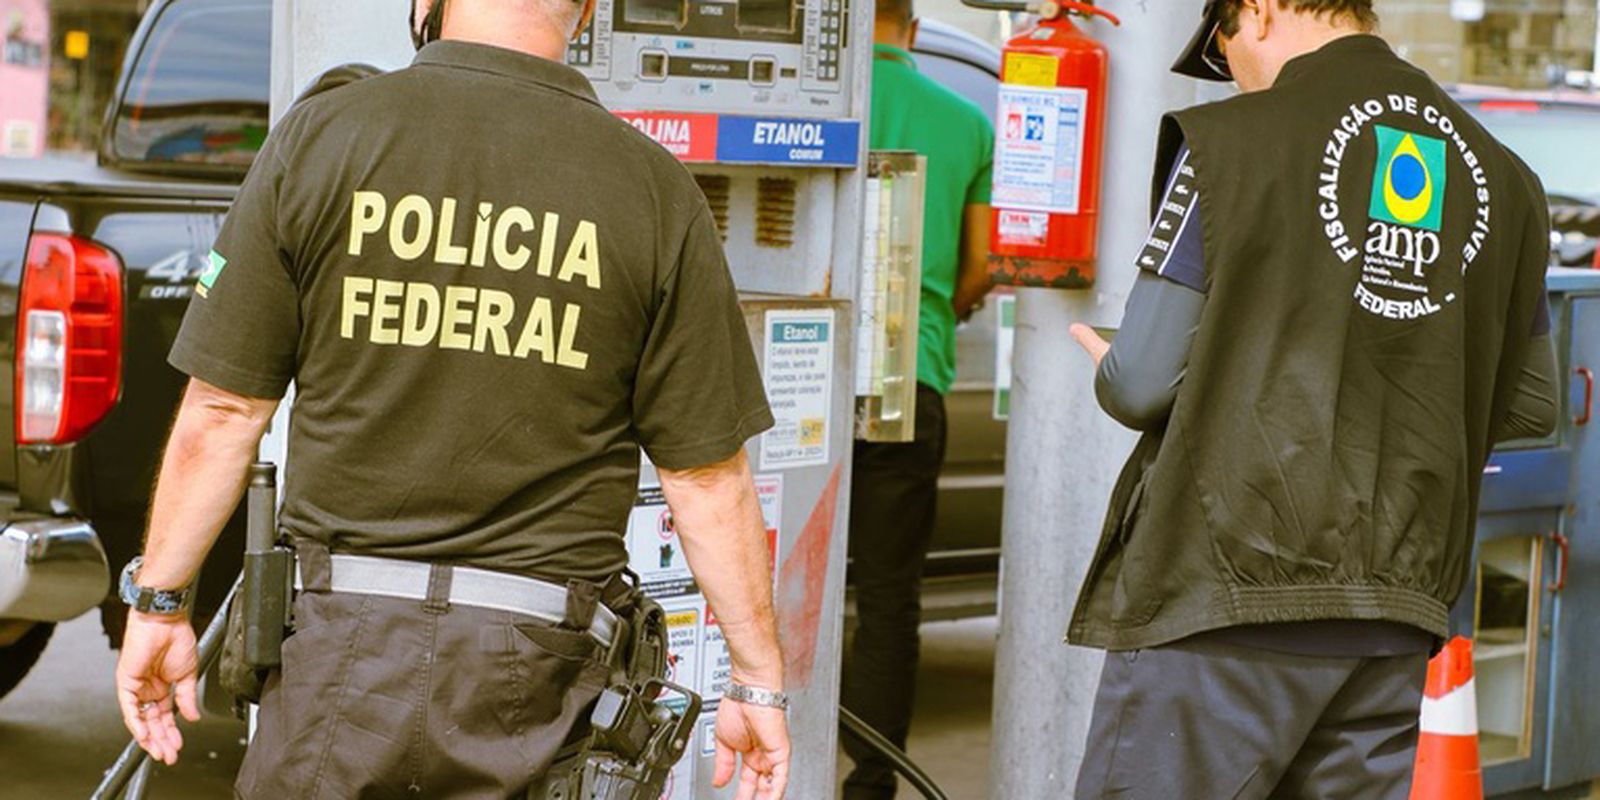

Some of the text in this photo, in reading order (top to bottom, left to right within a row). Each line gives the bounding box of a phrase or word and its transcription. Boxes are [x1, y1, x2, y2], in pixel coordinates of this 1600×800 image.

[629, 117, 691, 143] OLINA
[753, 121, 824, 146] ETANOL
[1318, 99, 1384, 263] FISCALIZAÇÃO
[1387, 94, 1418, 115] DE
[348, 191, 601, 290] POLÍCIA
[1365, 222, 1440, 277] anp
[340, 276, 589, 370] FEDERAL
[1353, 282, 1442, 320] FEDERAL
[783, 324, 818, 341] Etanol
